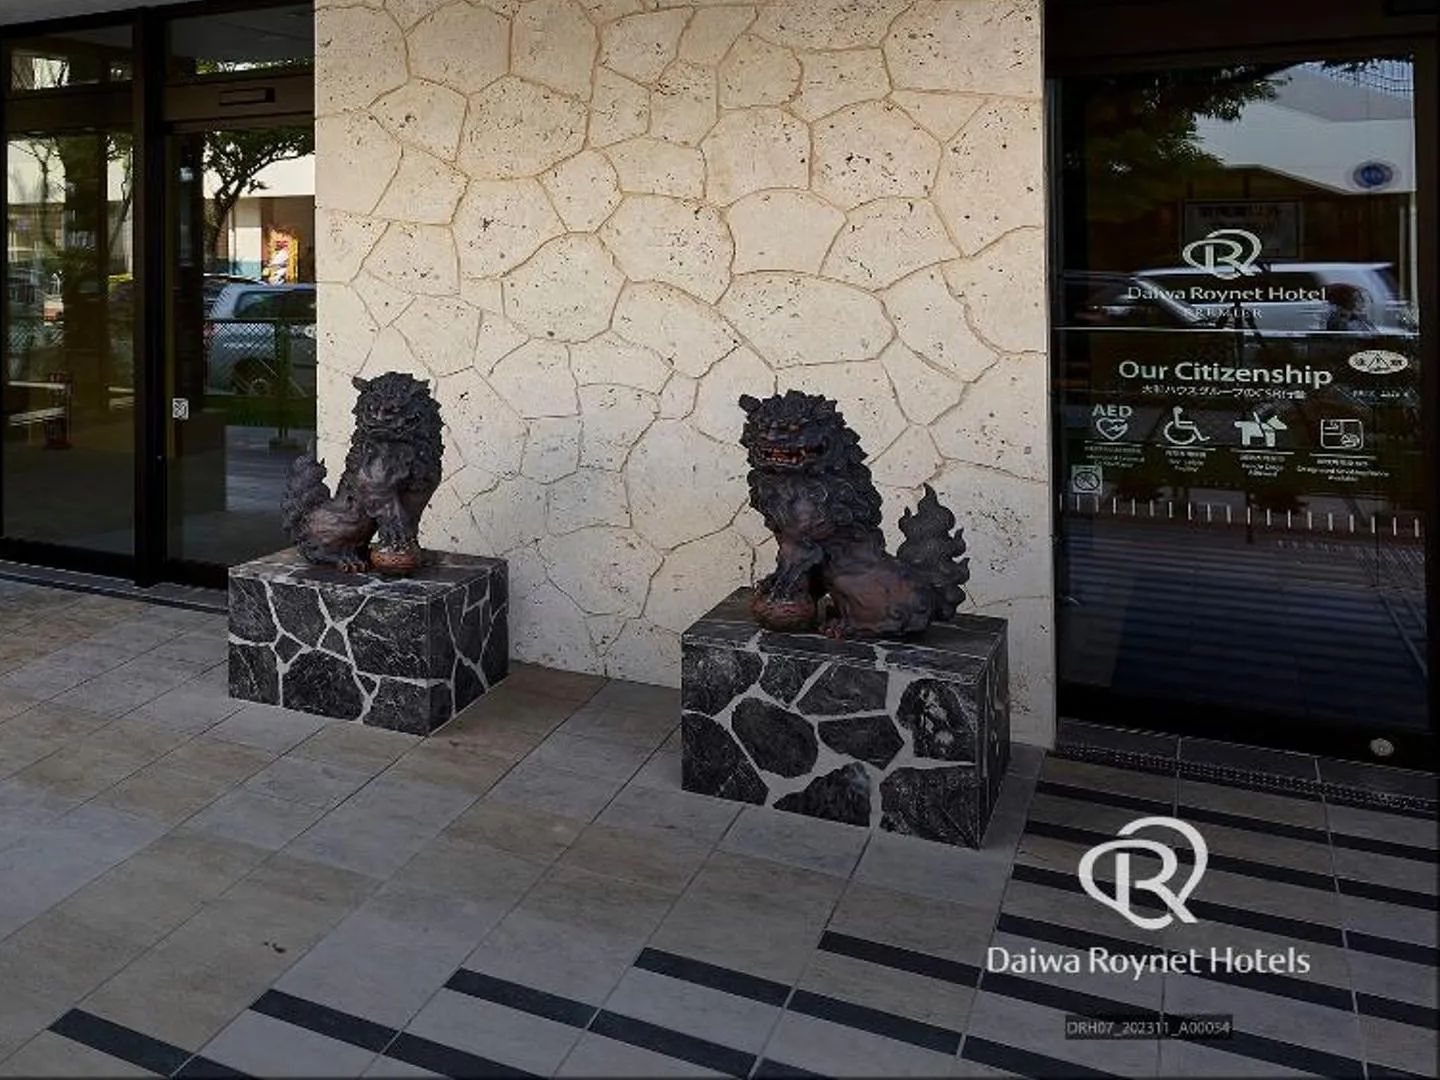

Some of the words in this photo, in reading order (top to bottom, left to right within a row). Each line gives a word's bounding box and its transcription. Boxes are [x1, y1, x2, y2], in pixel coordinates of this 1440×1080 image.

[1190, 286, 1264, 302] Roynet
[1268, 286, 1326, 302] Hotel
[1118, 360, 1169, 380] Our
[1174, 361, 1334, 390] Citizenship
[1092, 403, 1133, 418] AED
